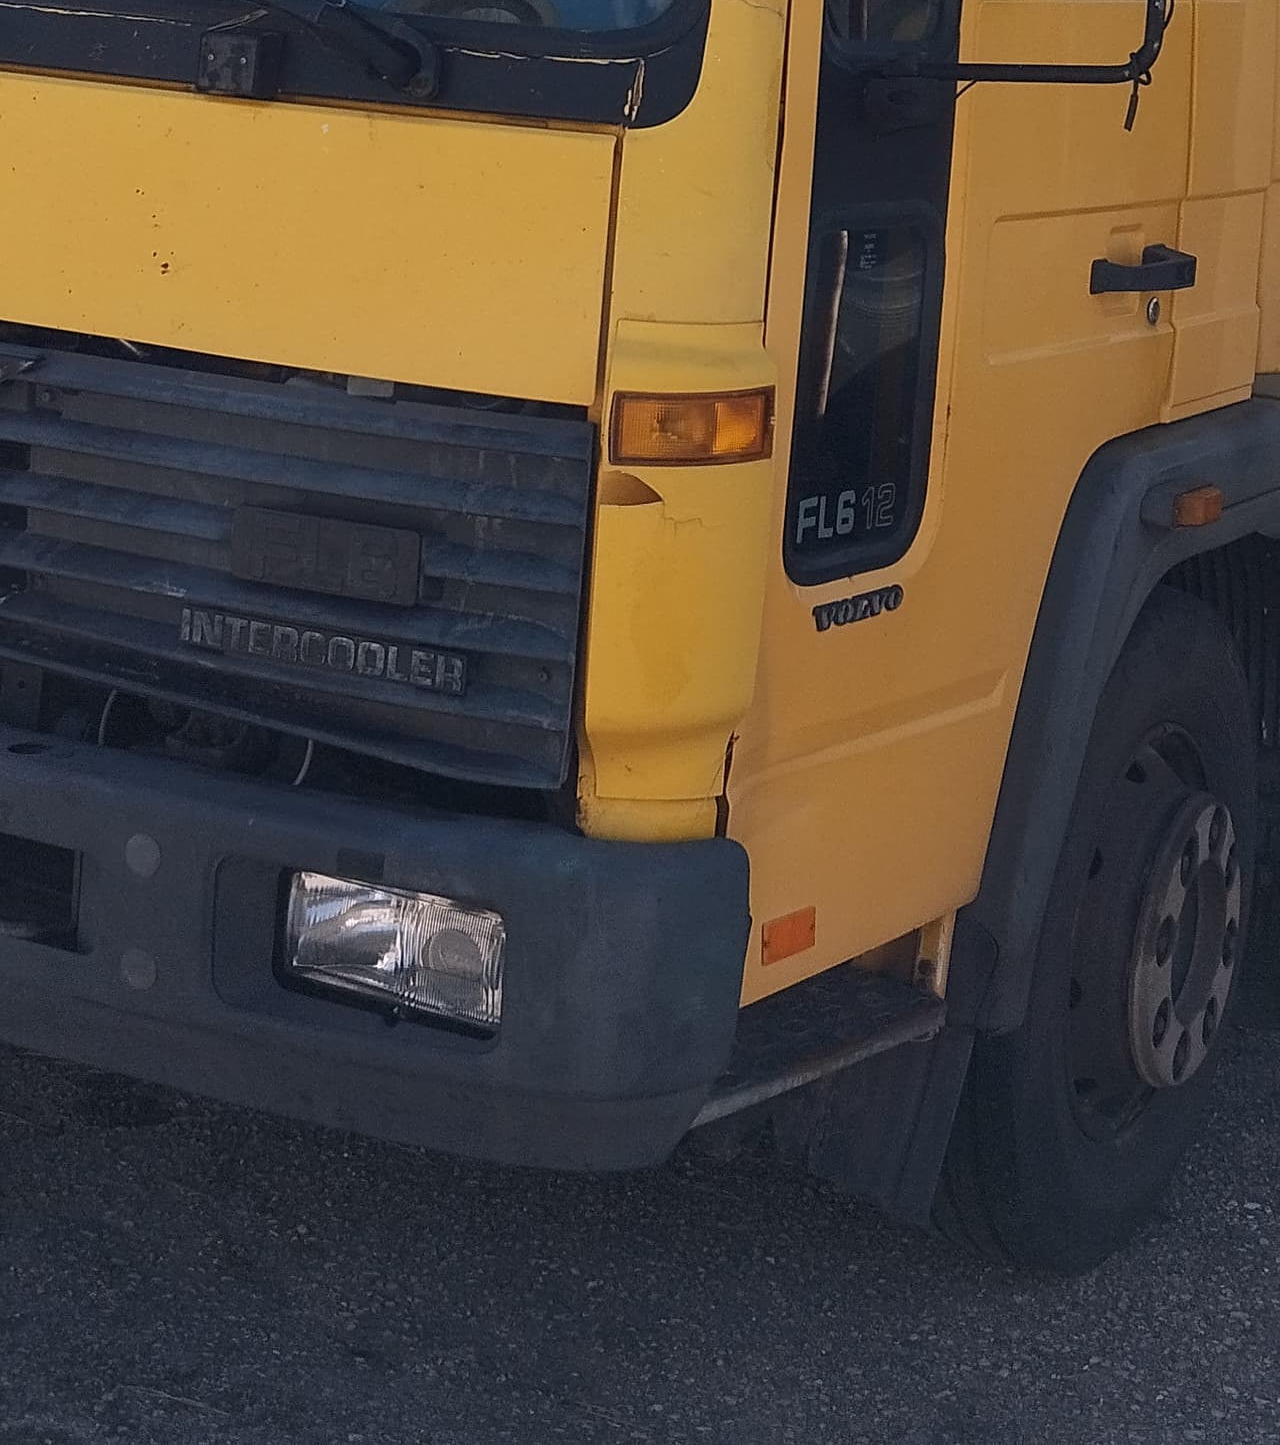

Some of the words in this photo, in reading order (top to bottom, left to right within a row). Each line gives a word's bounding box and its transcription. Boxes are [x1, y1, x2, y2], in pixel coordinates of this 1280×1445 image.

[796, 490, 856, 544] FL6
[861, 482, 896, 530] 12
[811, 584, 904, 632] VOLVO
[180, 607, 465, 693] INTERCOOLER
